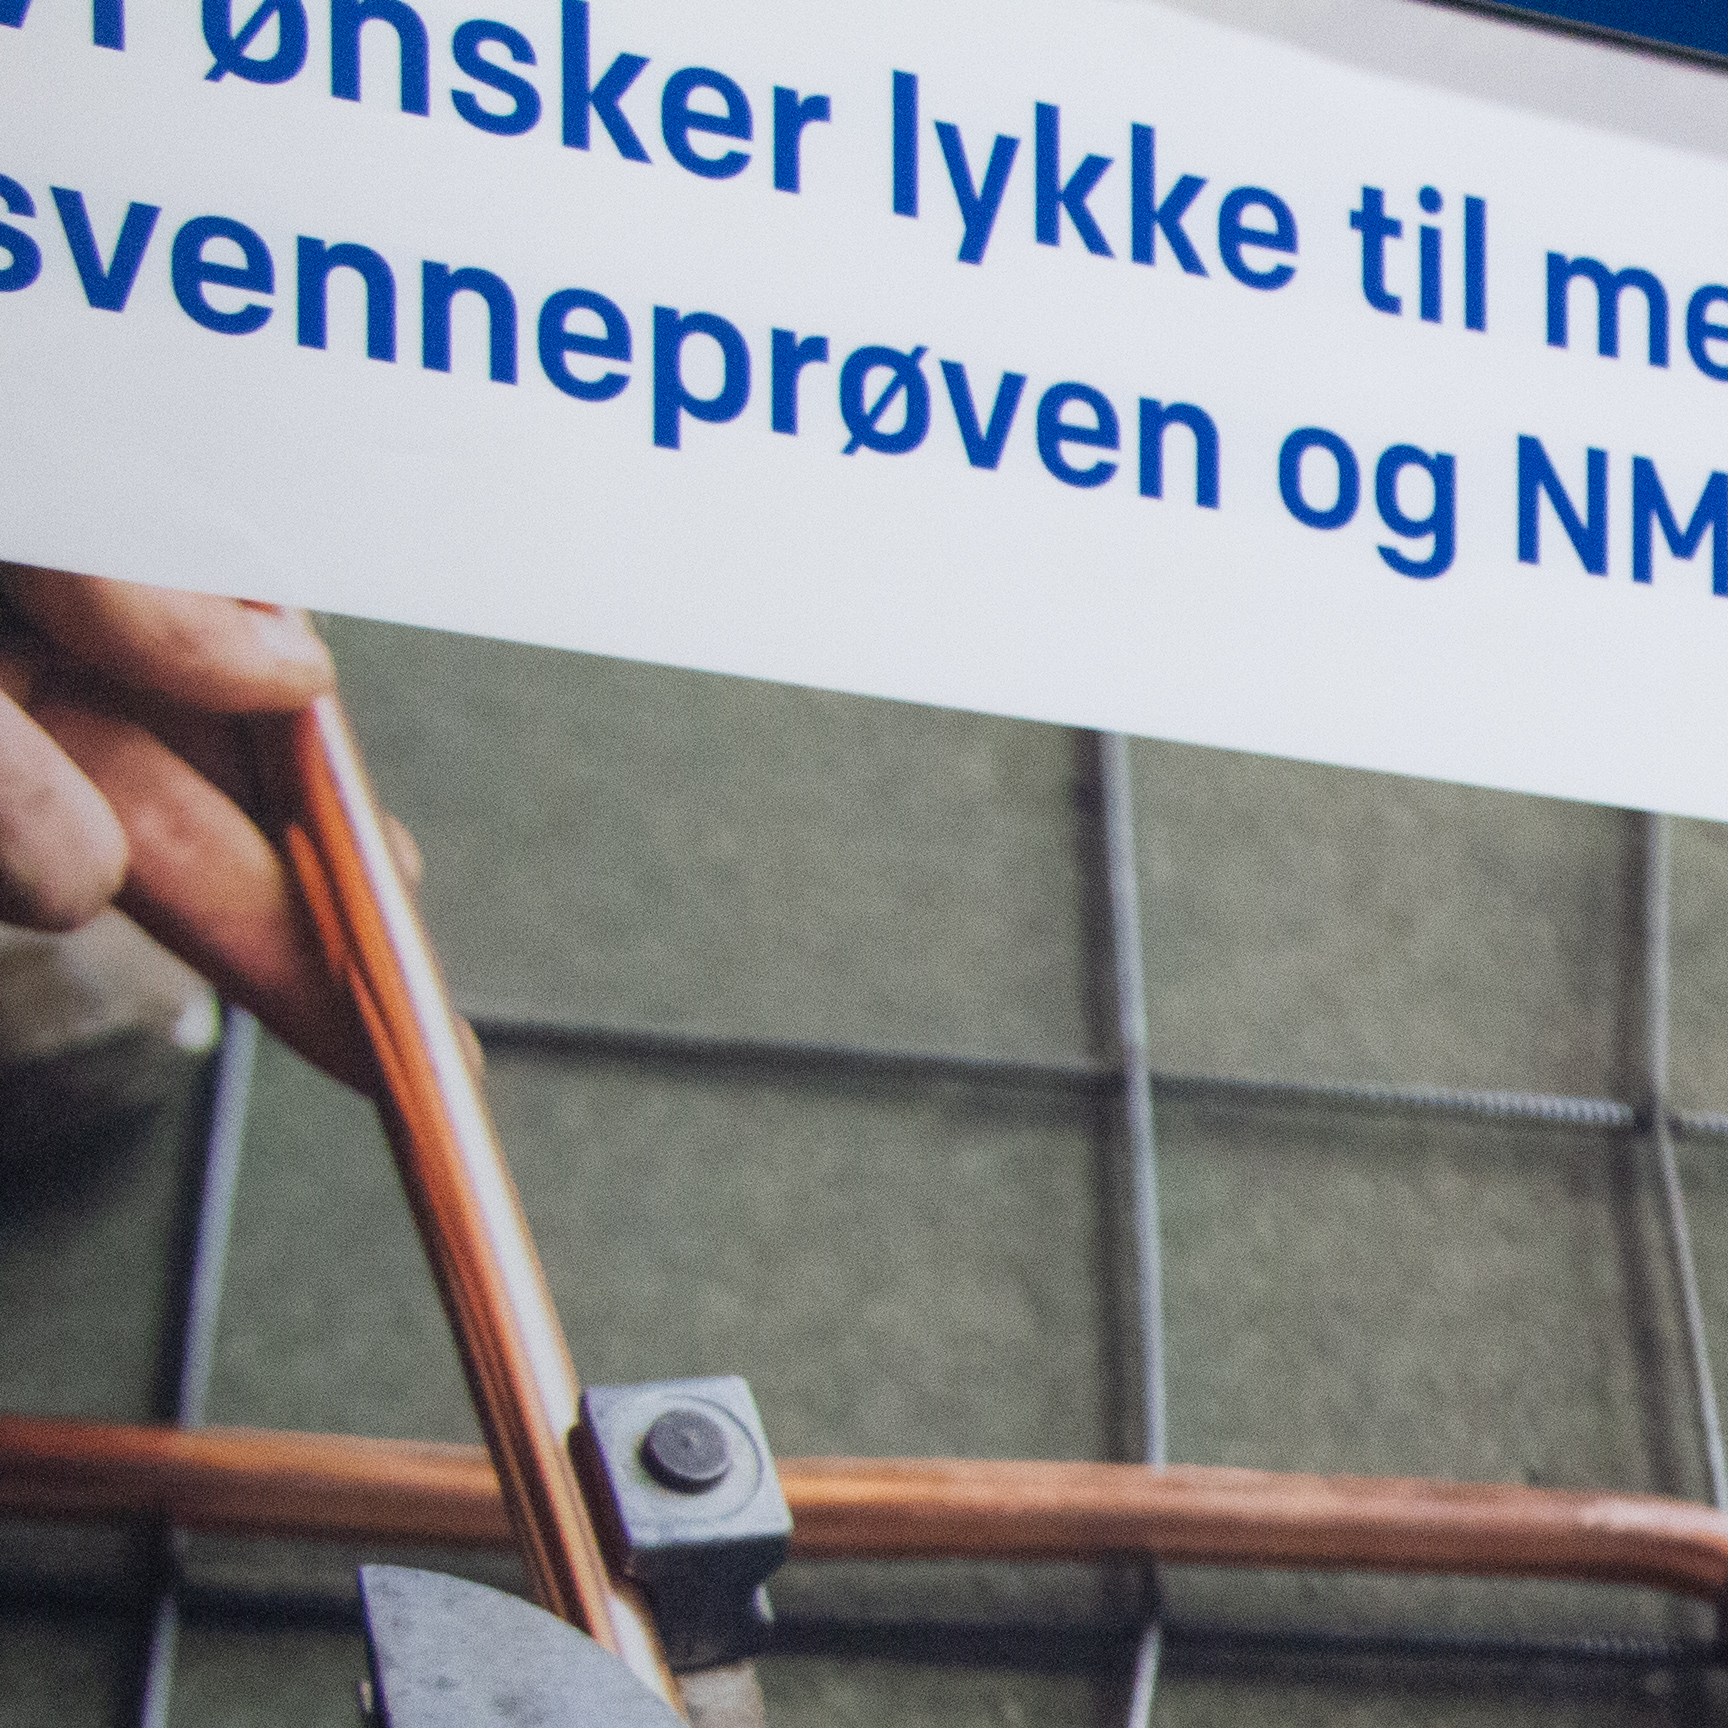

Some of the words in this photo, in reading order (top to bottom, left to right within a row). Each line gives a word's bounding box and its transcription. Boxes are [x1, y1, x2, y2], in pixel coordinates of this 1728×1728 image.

[202, 0, 831, 193] ønsker
[891, 69, 1299, 290] lykke
[1348, 184, 1487, 331] til
[1277, 425, 1457, 580] og
